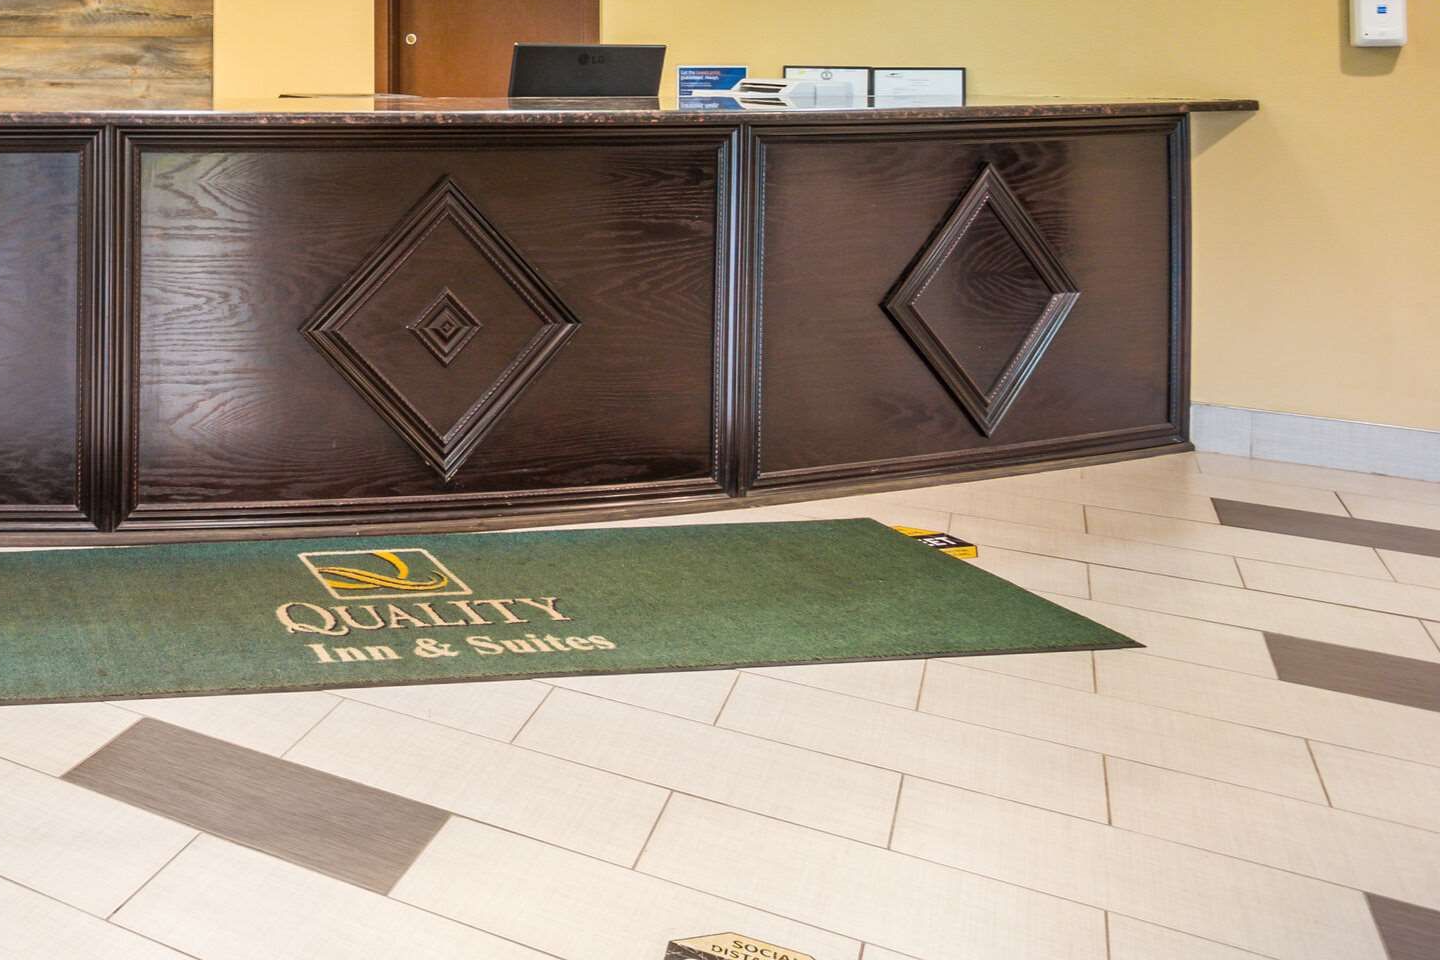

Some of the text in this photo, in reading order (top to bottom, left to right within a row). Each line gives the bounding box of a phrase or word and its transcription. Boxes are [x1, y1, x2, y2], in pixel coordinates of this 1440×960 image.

[276, 597, 574, 636] QUALITY
[305, 634, 617, 664] Inn & Suites
[732, 940, 798, 960] SOCIA
